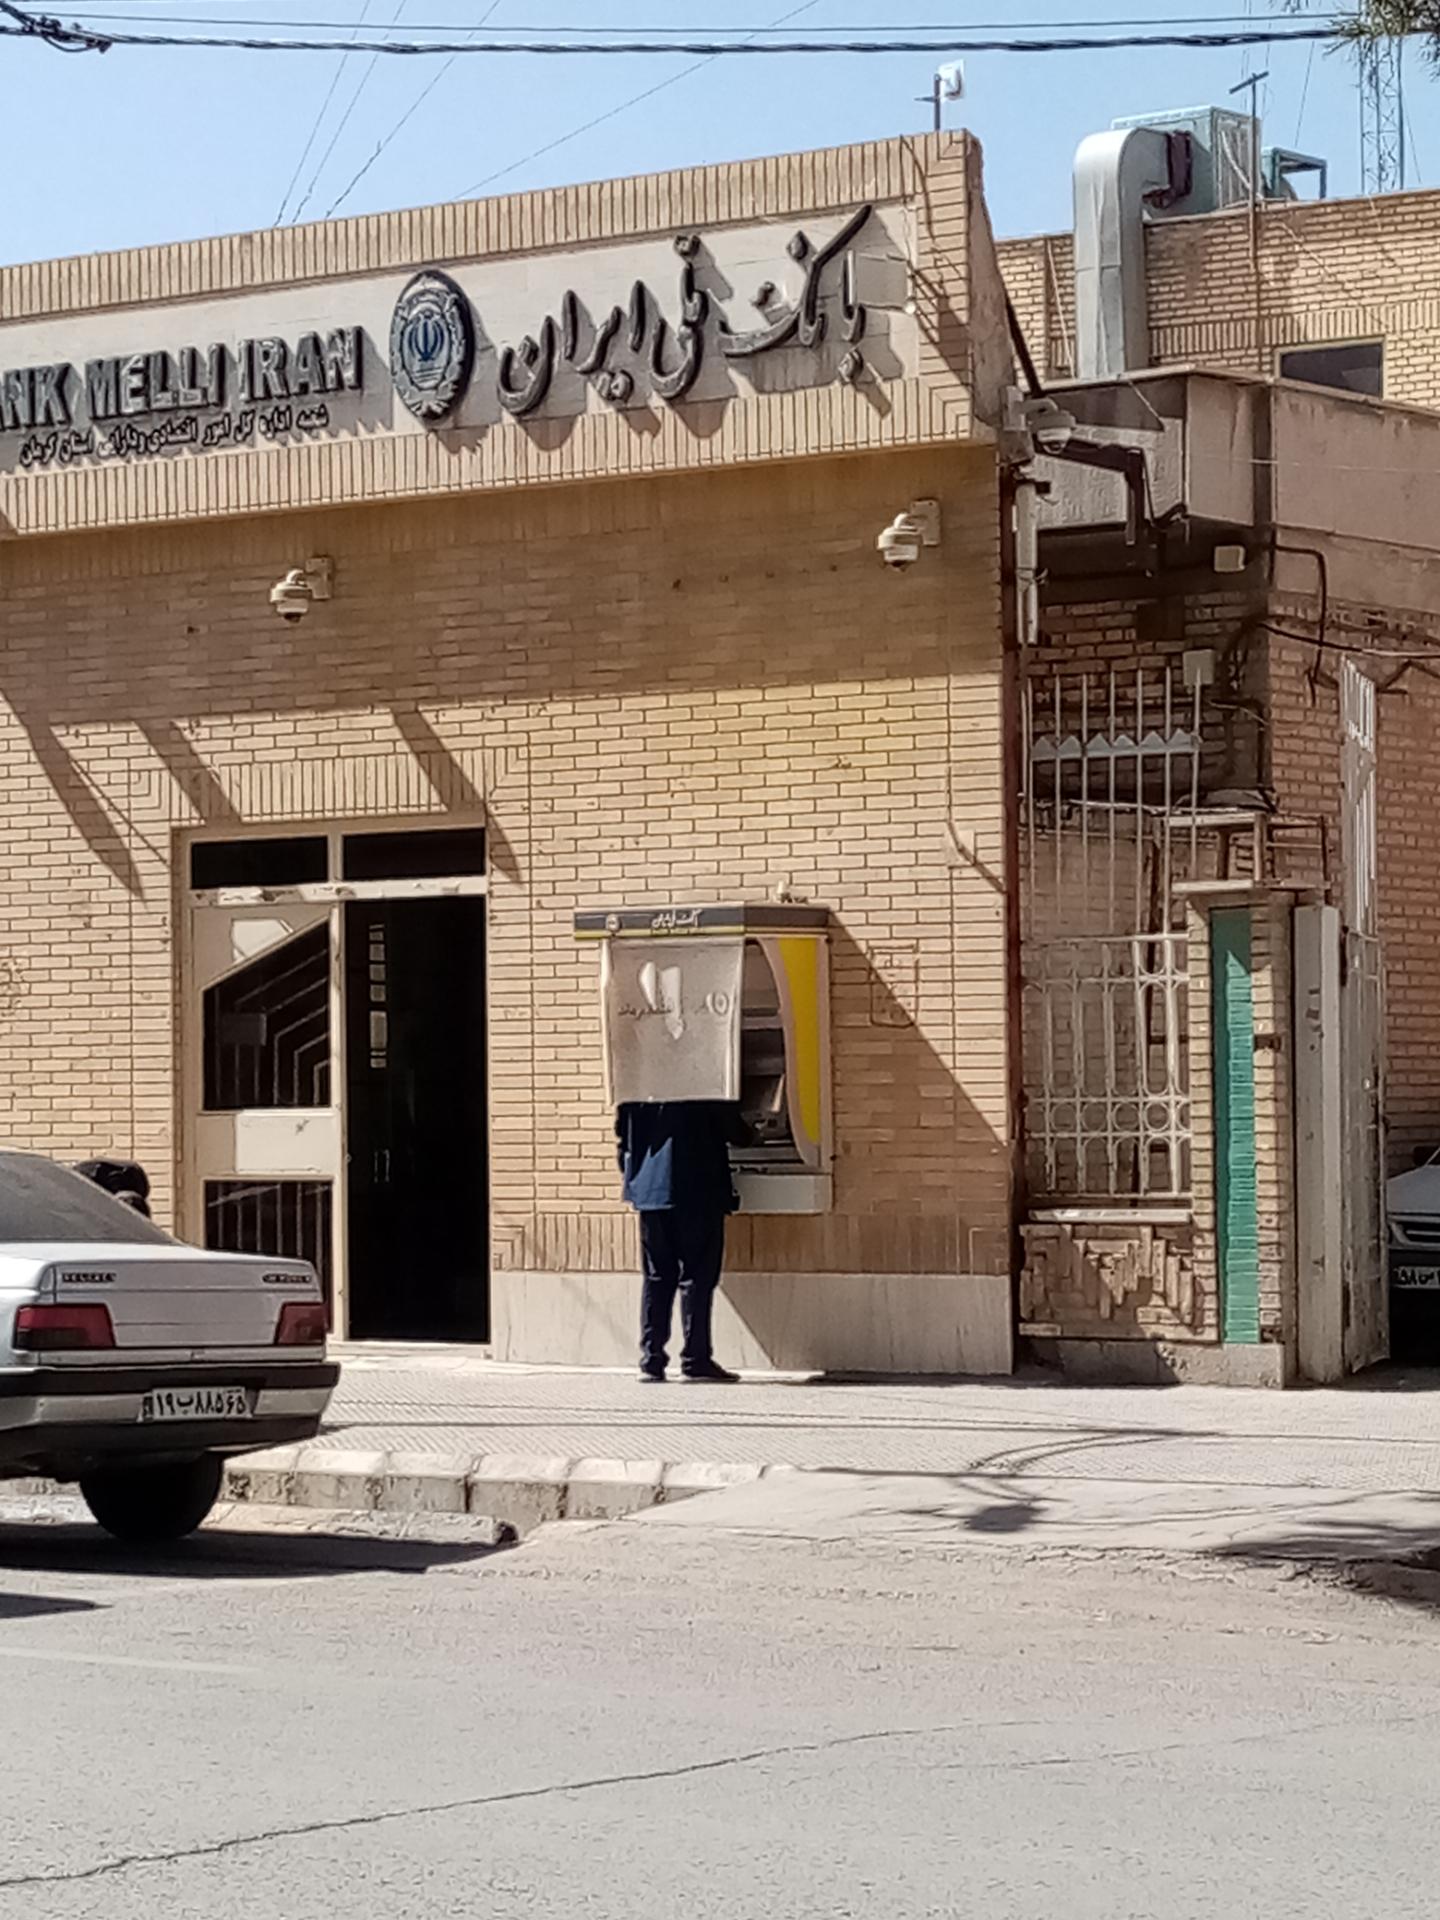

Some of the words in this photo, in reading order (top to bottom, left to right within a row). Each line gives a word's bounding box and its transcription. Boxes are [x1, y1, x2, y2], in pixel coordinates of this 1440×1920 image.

[496, 278, 647, 416] ایران
[649, 233, 710, 400] ملی
[719, 204, 873, 384] بانک
[85, 343, 227, 421] MELLI
[238, 325, 366, 403] IRAN
